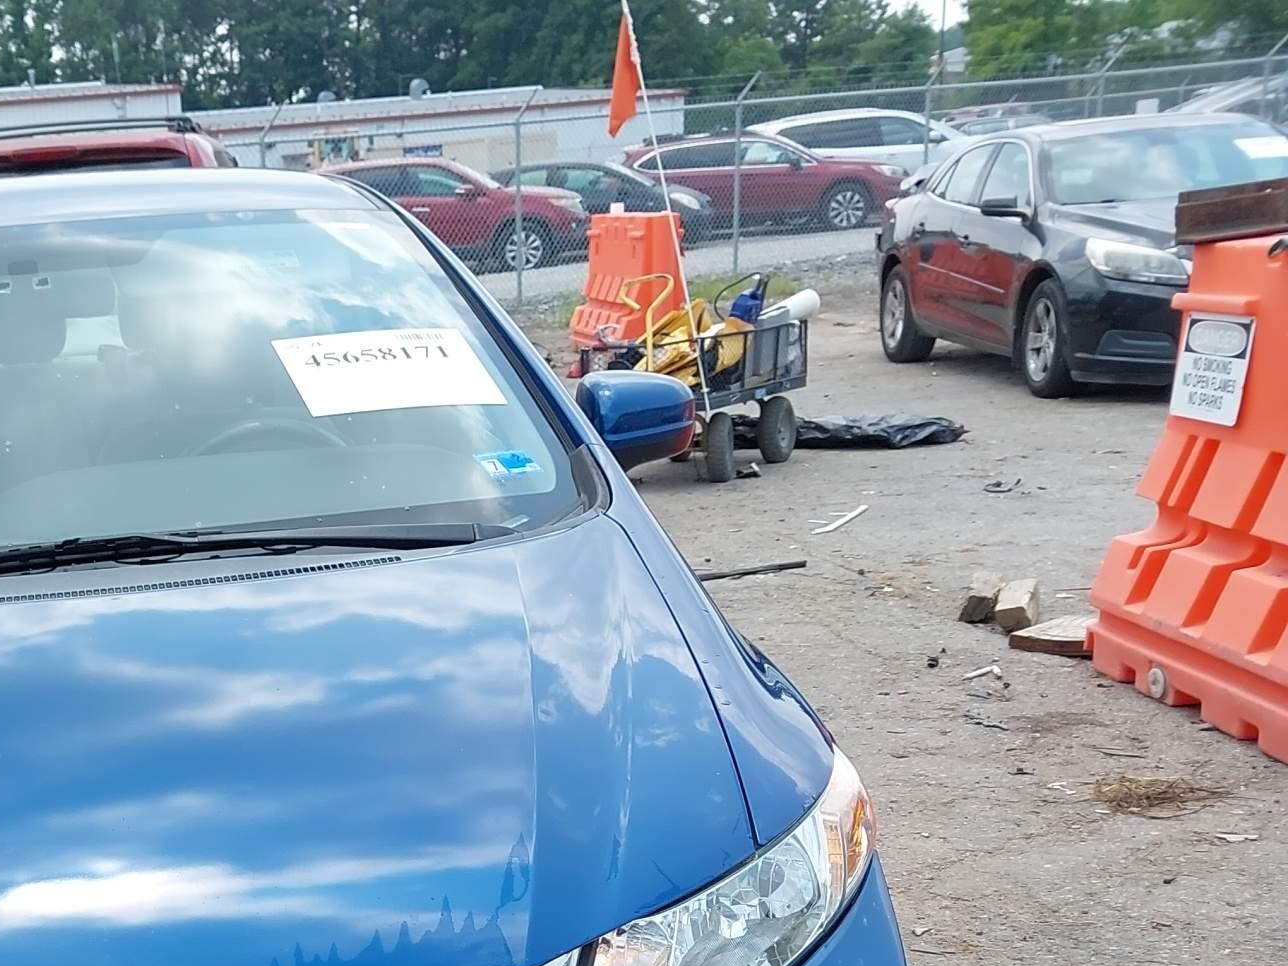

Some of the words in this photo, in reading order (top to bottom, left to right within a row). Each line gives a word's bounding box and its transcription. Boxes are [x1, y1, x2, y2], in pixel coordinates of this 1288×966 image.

[305, 345, 449, 367] 45658171
[1192, 356, 1202, 371] NO
[1202, 357, 1233, 375] SMOKING
[1182, 373, 1192, 387] NO
[1192, 374, 1210, 389] OPEN
[1210, 376, 1237, 394] FLAMES
[1188, 391, 1198, 405] NO
[1198, 391, 1224, 410] SPARKS
